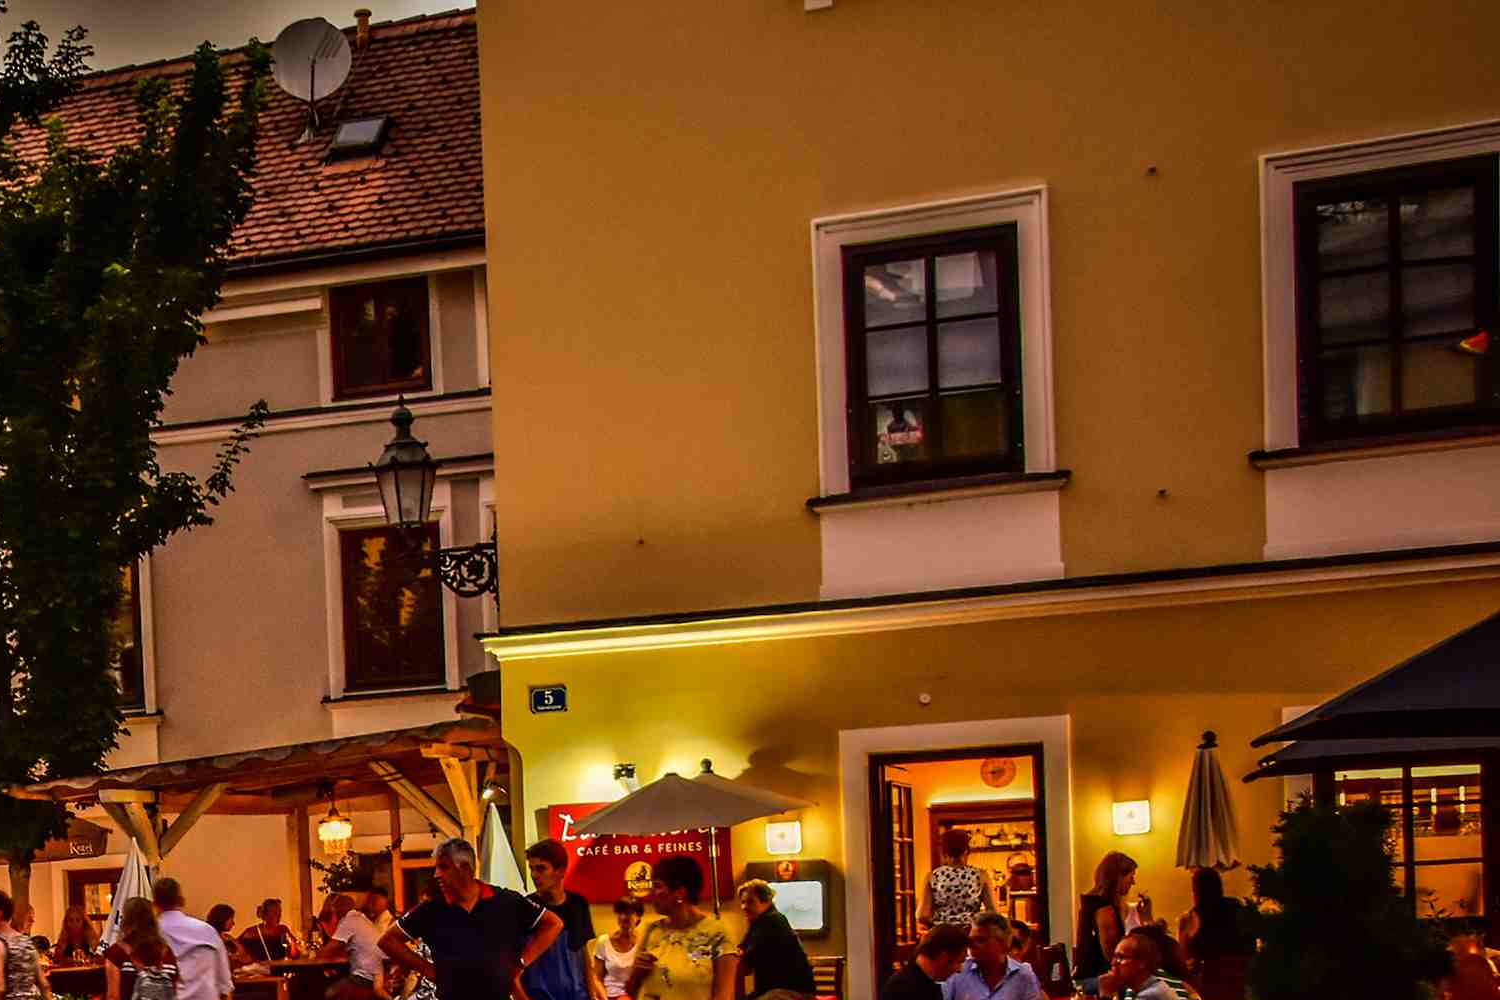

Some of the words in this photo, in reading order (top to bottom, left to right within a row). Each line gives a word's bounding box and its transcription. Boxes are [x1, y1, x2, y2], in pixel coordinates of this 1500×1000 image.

[544, 690, 554, 705] 5
[576, 844, 608, 857] CAFÉ
[613, 844, 639, 855] BAR
[643, 845, 652, 854] &
[657, 841, 703, 853] FEINES
